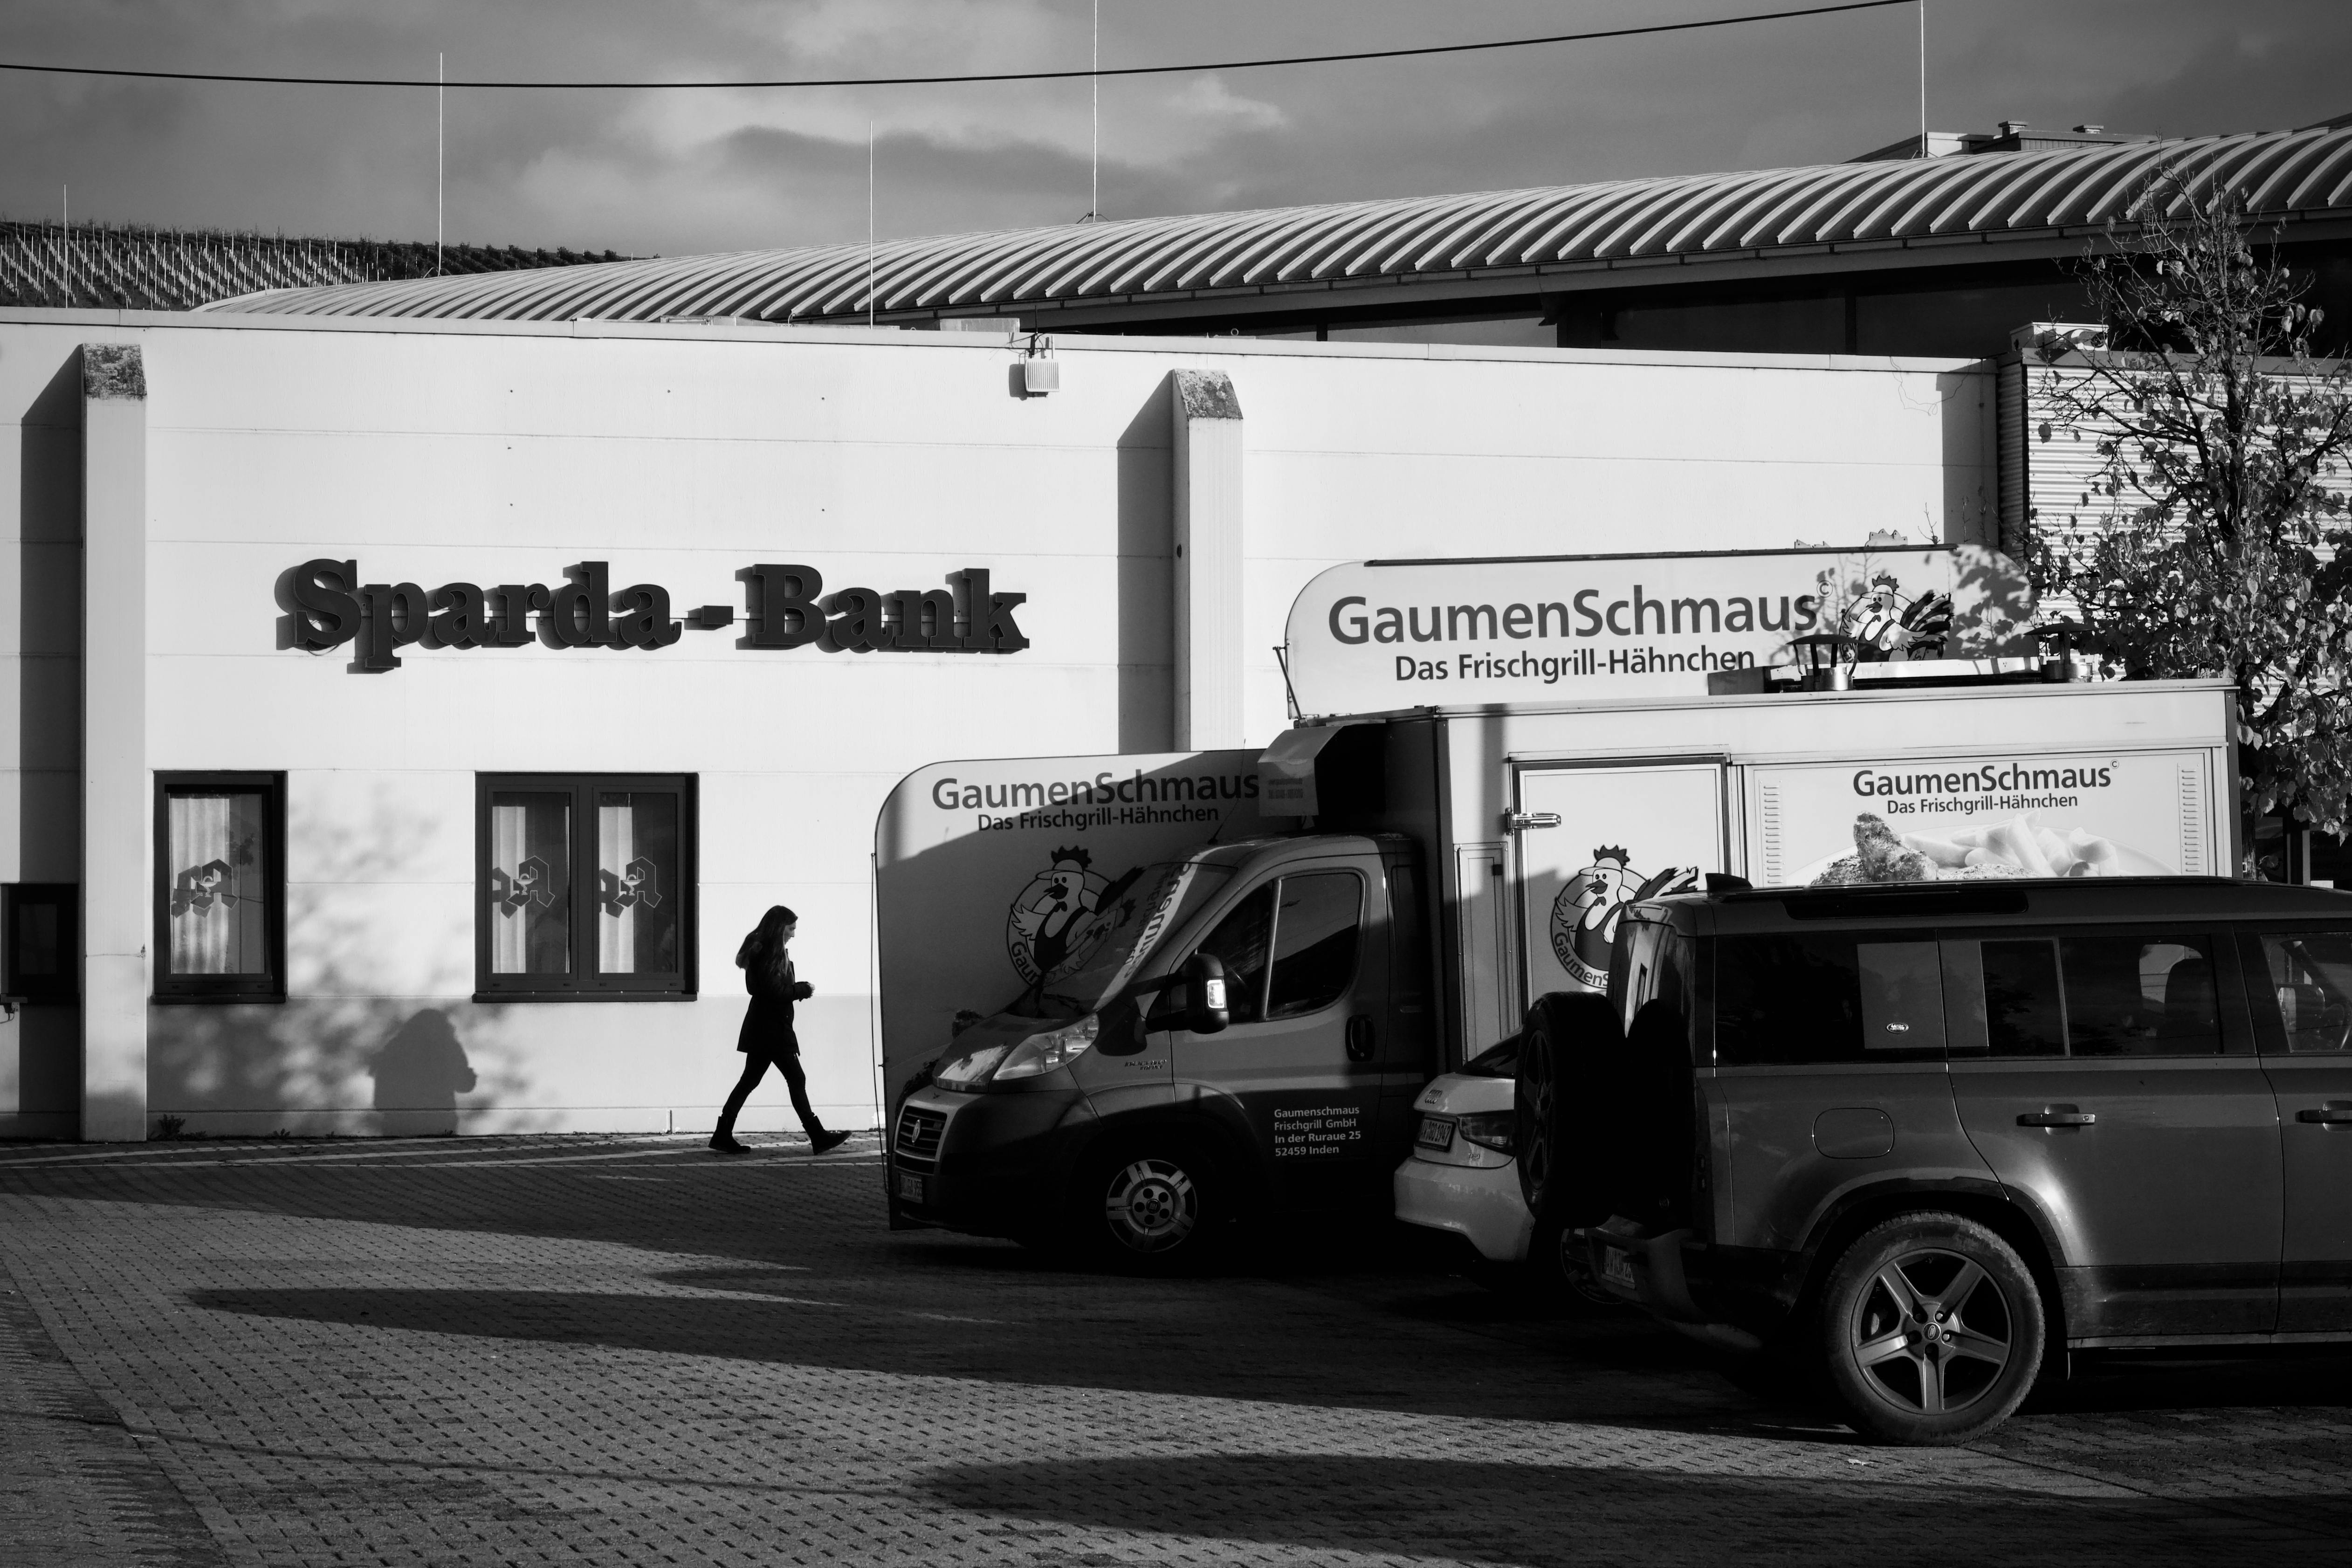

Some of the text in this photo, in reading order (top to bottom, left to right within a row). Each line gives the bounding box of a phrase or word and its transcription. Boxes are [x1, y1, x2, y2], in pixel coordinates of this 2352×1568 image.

[1328, 585, 1818, 645] GaumenSchmaus
[1396, 645, 1755, 684] Das Frischgrill-Hähnchen
[932, 769, 1259, 810] GaumenSchmaus
[1853, 763, 2111, 797] GaumenSchmaus
[1887, 793, 2078, 815] Das Frischgrill-Hähnchen
[978, 805, 1219, 831] Das Frischgrill-Hähnchen
[1274, 1106, 1360, 1118] Gaumenschmaus
[1274, 1118, 1356, 1132] Frischgrill GmbH
[1275, 1131, 1361, 1143] In der Ruraue 25
[1275, 1145, 1339, 1156] 52459 Inden
